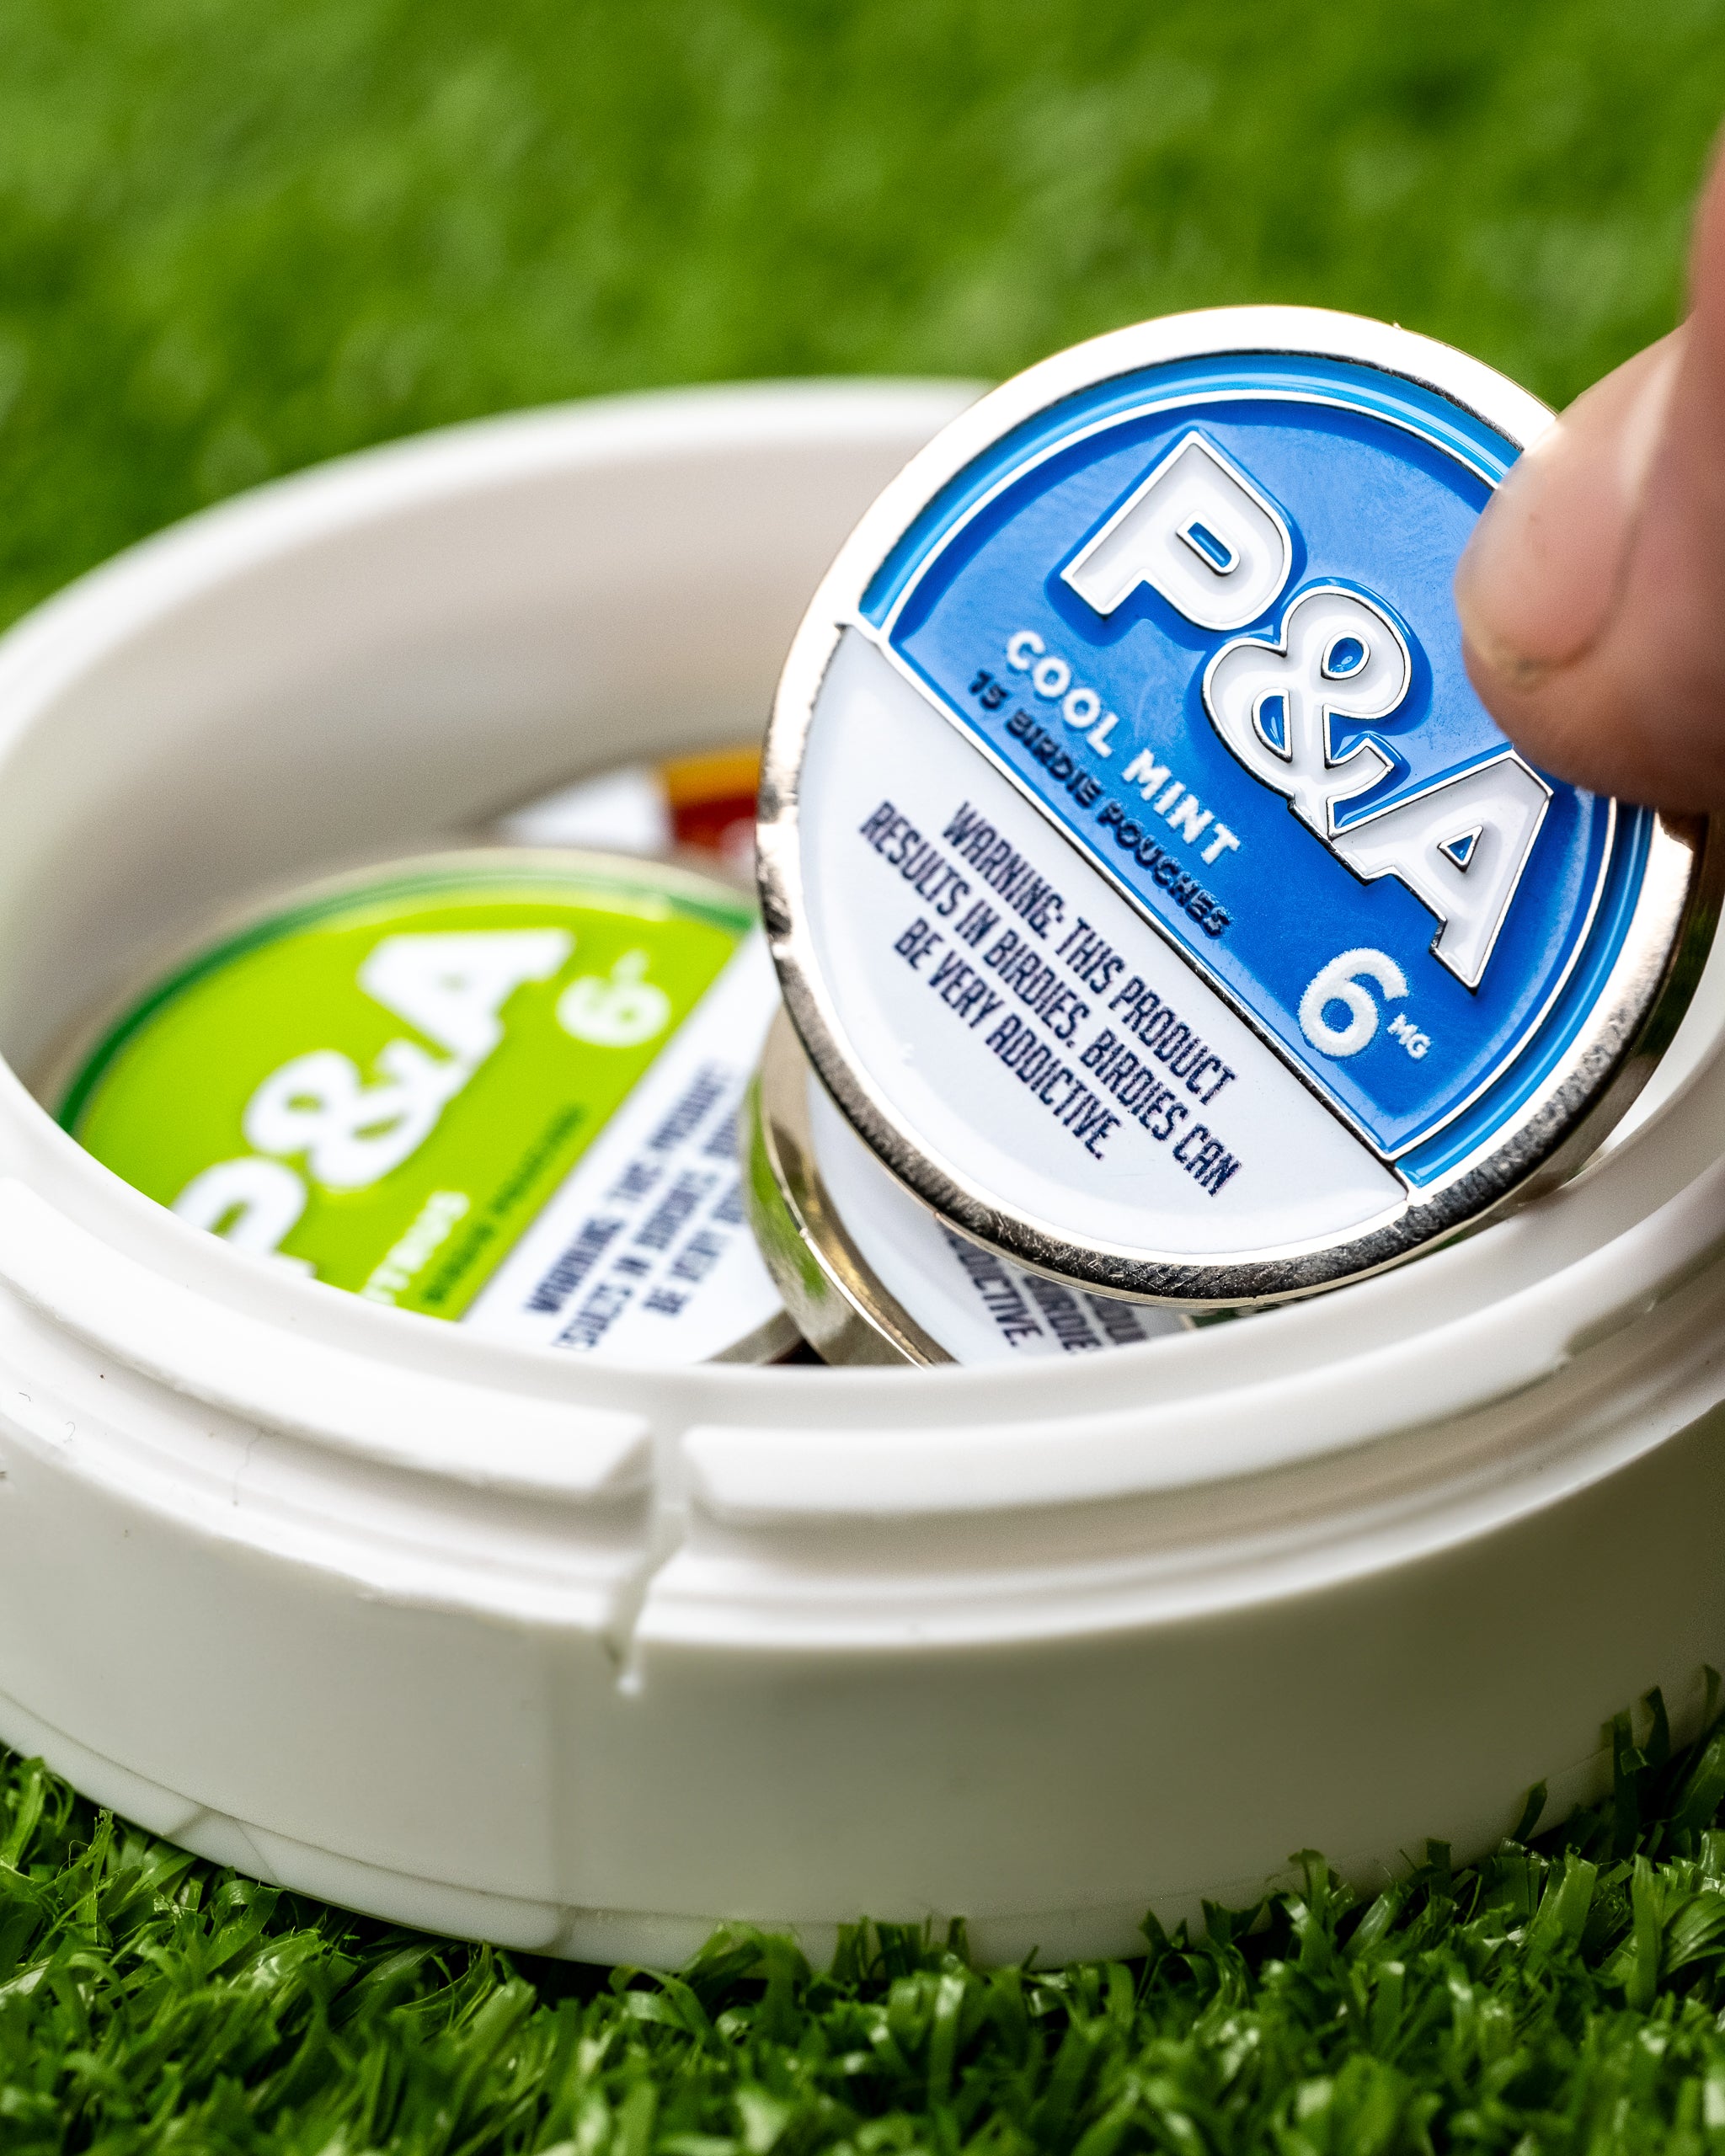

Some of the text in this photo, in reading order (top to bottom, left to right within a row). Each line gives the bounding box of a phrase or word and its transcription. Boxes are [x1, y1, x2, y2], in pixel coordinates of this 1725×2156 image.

[969, 670, 1231, 938] 15 BIRDIE POUCHES
[1007, 630, 1242, 865] COOL MINT
[1061, 431, 1551, 990] P&A
[859, 799, 1242, 1198] RESULTS IN BIRDIES. BIRDIES CAN
[894, 917, 1122, 1161] BE VERY ADDICTIVE.
[1055, 917, 1126, 995] THIS
[1108, 974, 1238, 1106] PRODUCT
[1298, 947, 1432, 1059] 6 MG
